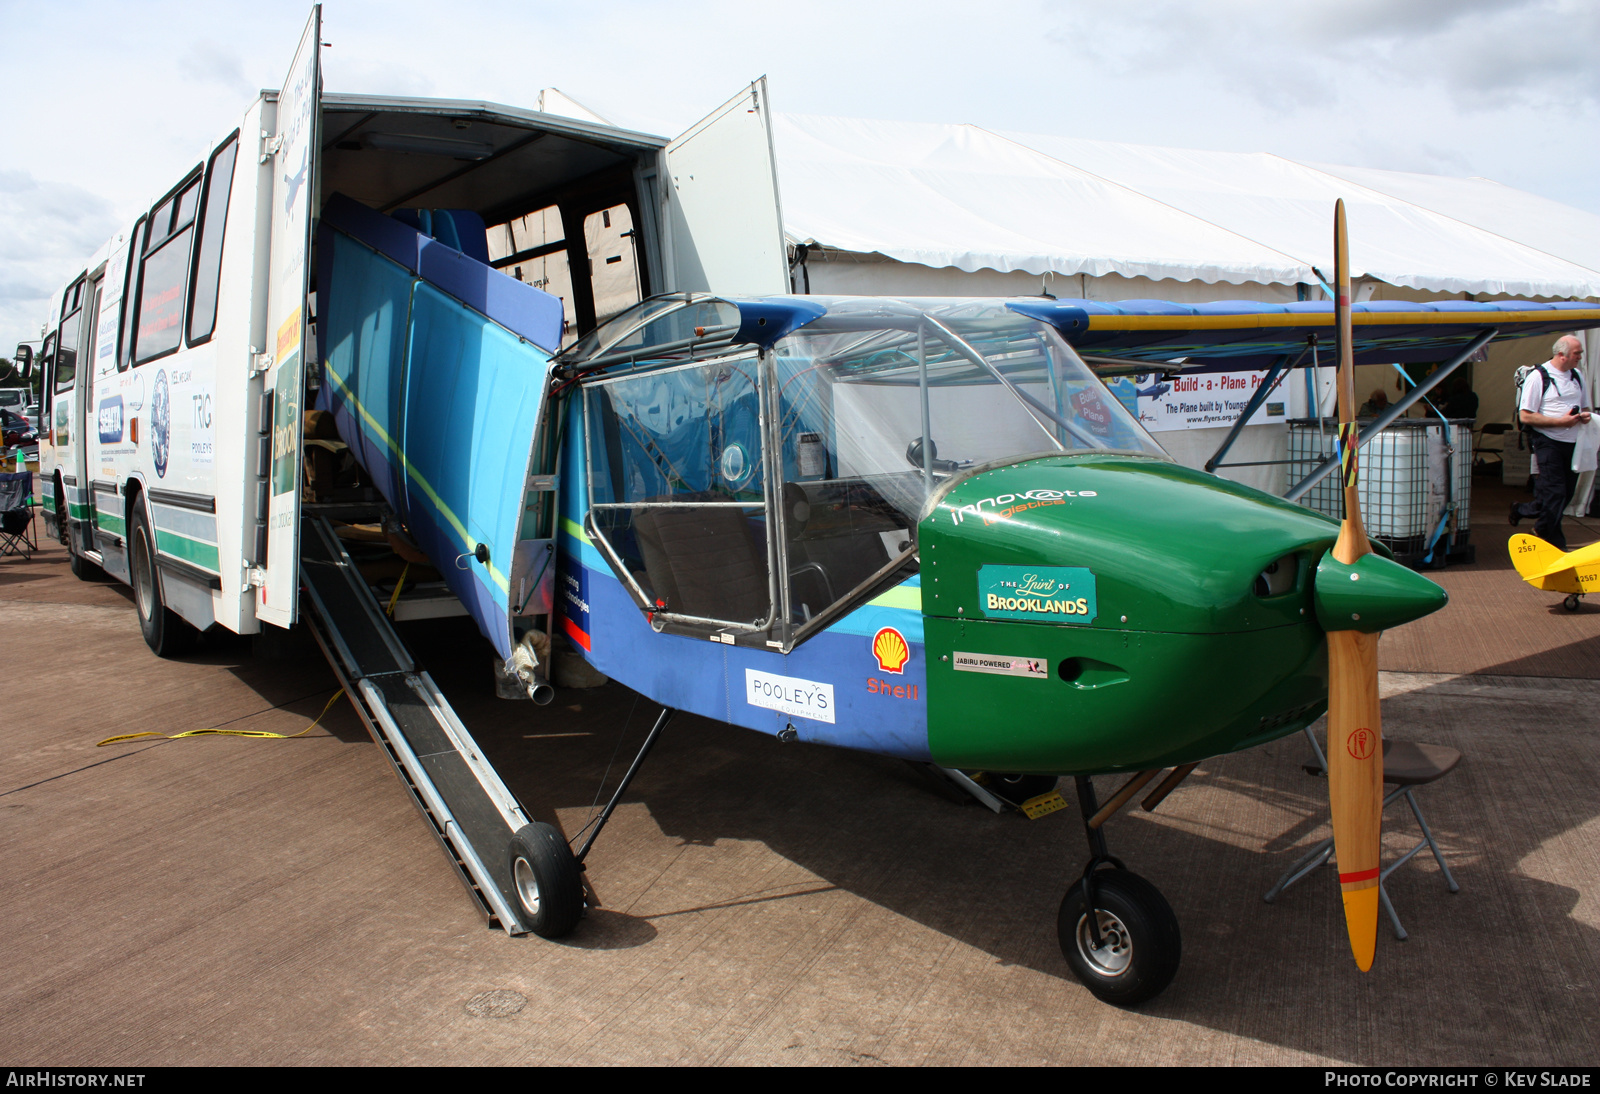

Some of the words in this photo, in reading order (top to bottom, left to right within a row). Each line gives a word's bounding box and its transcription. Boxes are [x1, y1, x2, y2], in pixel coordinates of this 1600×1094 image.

[1173, 376, 1199, 393] Build
[1206, 380, 1213, 391] a
[1220, 375, 1247, 390] Plane
[1083, 407, 1105, 423] Plane
[1165, 402, 1179, 414] The
[1179, 401, 1198, 413] Plane
[1199, 400, 1214, 412] built
[1215, 400, 1224, 413] by
[1517, 544, 1537, 554] 2567
[1521, 538, 1528, 546] K
[999, 580, 1018, 589] THE
[1015, 573, 1060, 598] Spirit
[1058, 583, 1071, 591] OF
[987, 592, 1090, 616] BROOKLANDS
[955, 657, 979, 667] JABIRU
[979, 659, 1011, 669] POWERED
[866, 677, 919, 701] Shell
[754, 698, 779, 710] FLIGHT
[780, 705, 830, 721] EQUIPMENT
